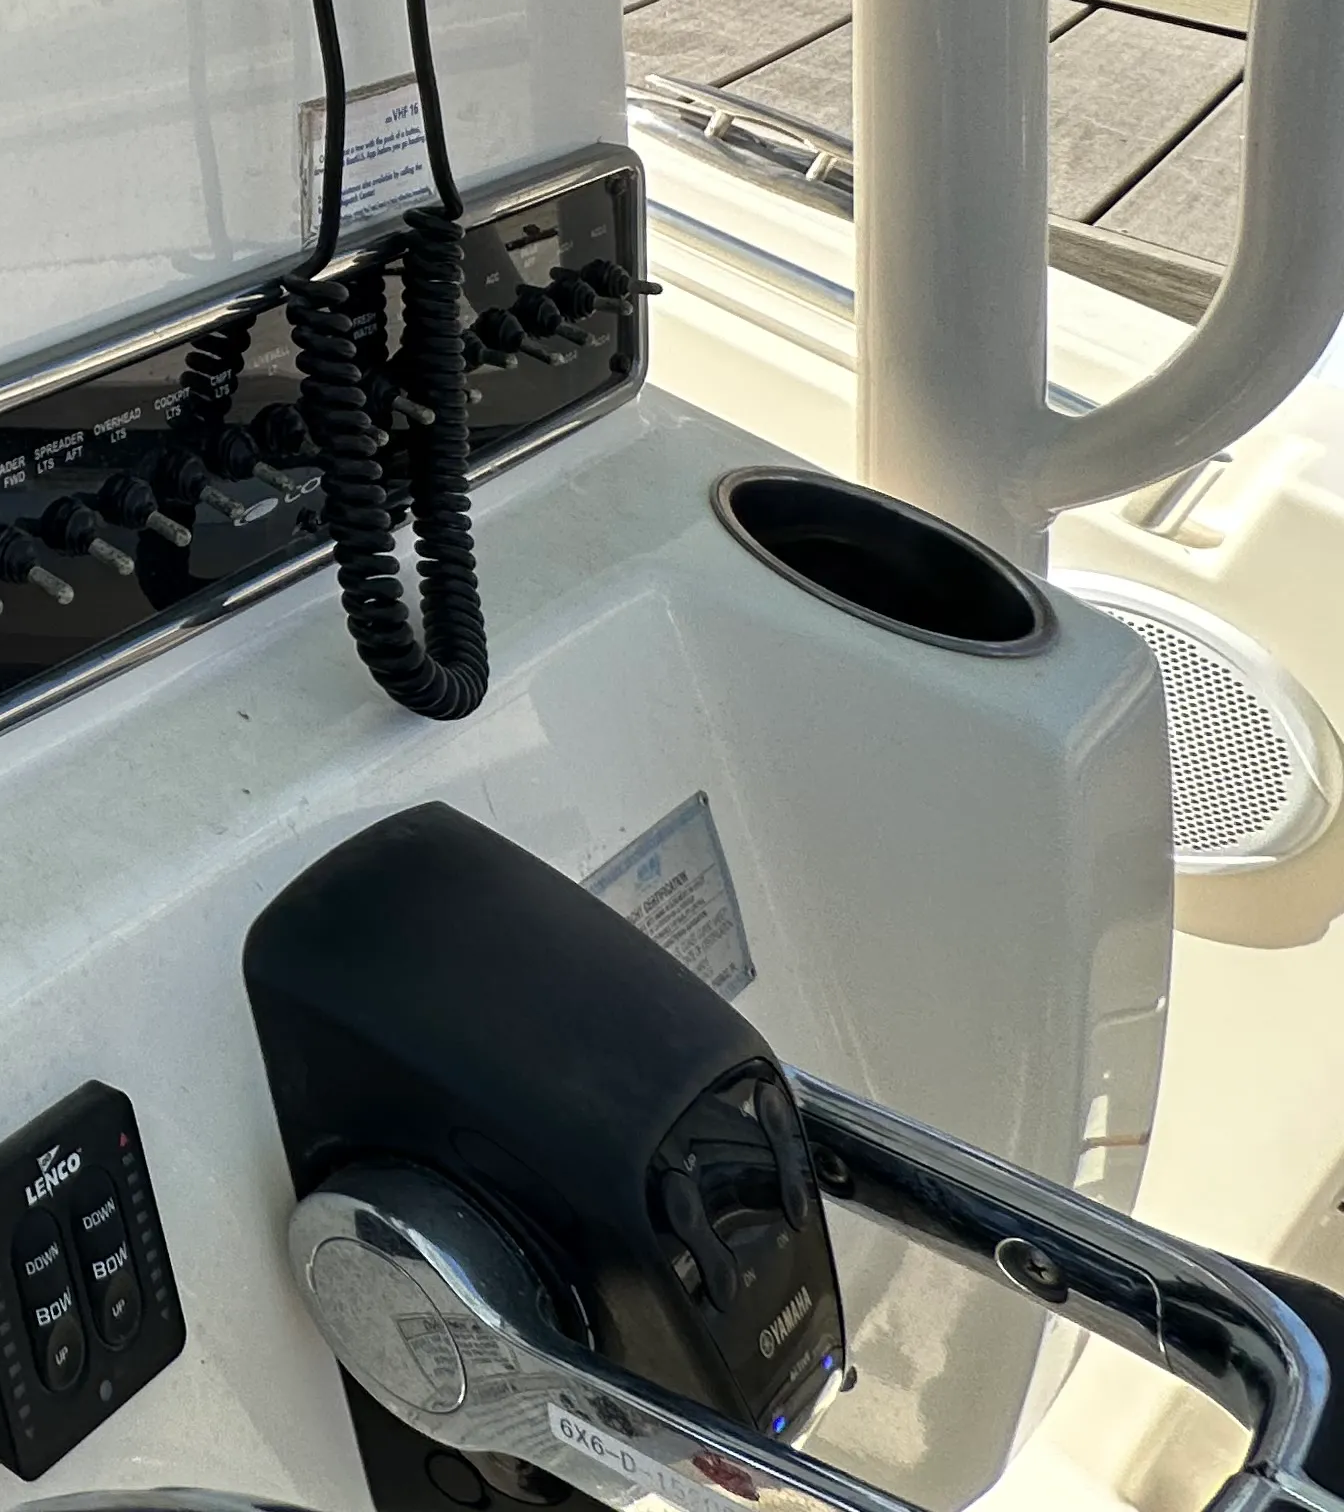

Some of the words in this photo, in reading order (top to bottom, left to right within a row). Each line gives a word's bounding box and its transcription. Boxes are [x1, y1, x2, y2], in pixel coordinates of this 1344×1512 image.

[92, 407, 142, 437] OVERHEAD
[164, 403, 182, 421] LTS
[33, 430, 85, 461] SPREADER
[109, 427, 127, 444] LTS
[36, 457, 55, 475] LTS
[64, 445, 84, 464] AFT
[3, 470, 27, 490] FWD
[23, 1148, 83, 1206] LENCO
[82, 1196, 117, 1232] DOWN
[25, 1241, 60, 1276] DOWN
[92, 1241, 130, 1281] BOW
[35, 1286, 73, 1327] BOW
[111, 1298, 127, 1320] UP
[768, 1285, 813, 1346] YAMAHA
[53, 1345, 70, 1368] UP
